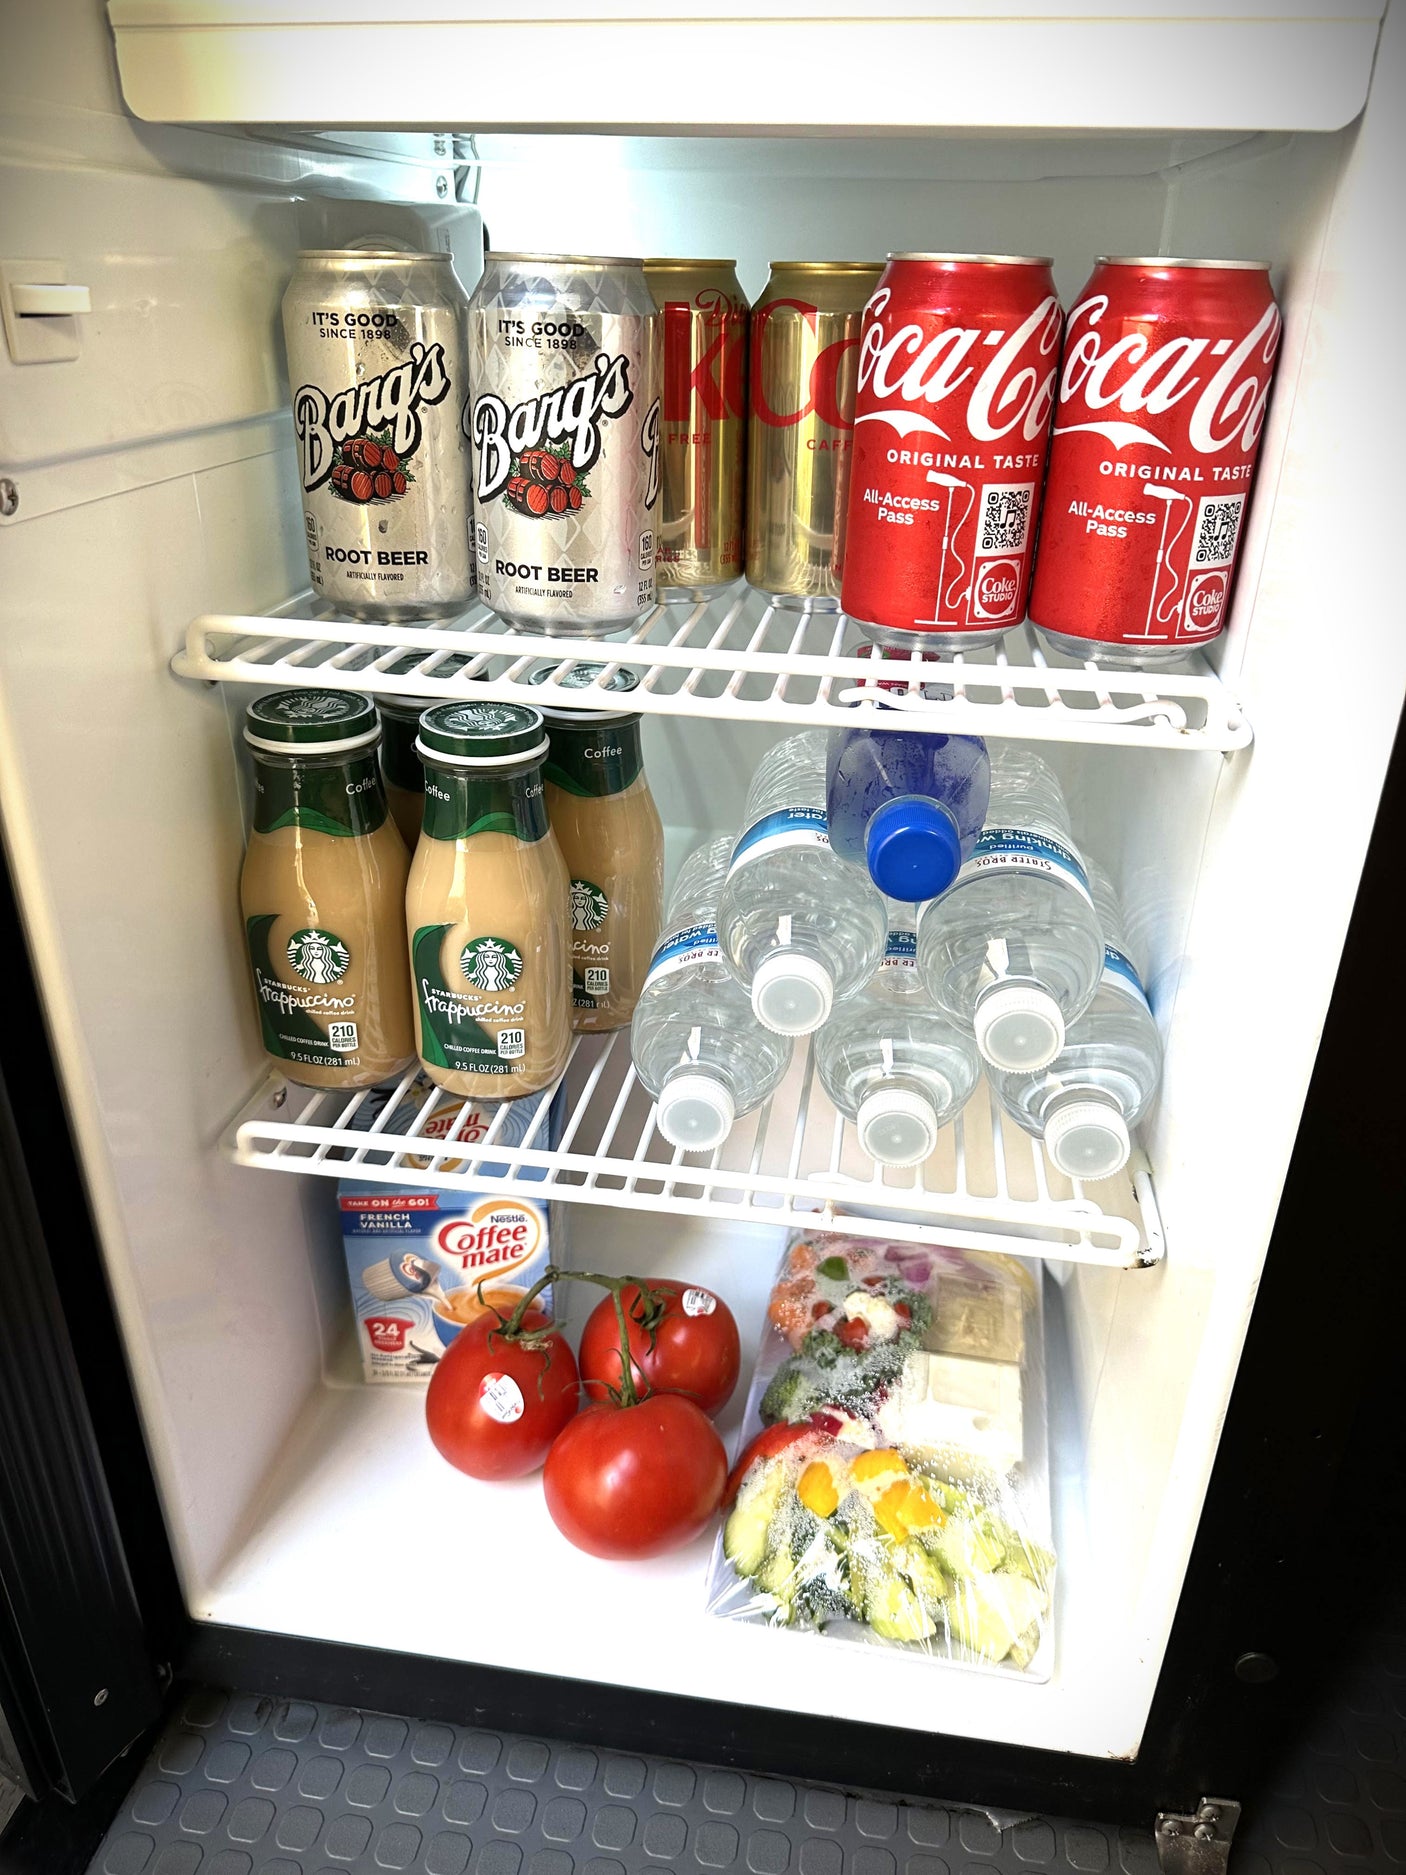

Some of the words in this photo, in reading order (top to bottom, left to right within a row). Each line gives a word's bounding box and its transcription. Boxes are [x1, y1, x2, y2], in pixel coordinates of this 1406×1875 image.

[312, 312, 339, 327] IT'S
[344, 313, 398, 328] GOOD
[320, 328, 356, 340] SINCE
[360, 329, 391, 341] 1898
[498, 319, 527, 336] IT'S
[532, 321, 585, 338] GOOD
[504, 336, 542, 349] SINCE
[546, 338, 578, 350] 1898
[293, 342, 451, 493] Barq's
[473, 352, 633, 504] Barq's
[669, 433, 711, 445] FREE
[807, 440, 853, 451] CAFF
[887, 449, 984, 469] ORIGINAL
[993, 454, 1039, 470] TASTE
[1100, 461, 1204, 482] ORIGINAL
[1212, 464, 1253, 481] TASTE
[864, 488, 940, 512] All-Access
[878, 508, 914, 526] Pass
[1068, 500, 1156, 525] All-Access
[1086, 520, 1128, 538] Pass
[325, 546, 373, 566] ROOT
[377, 550, 429, 566] BEER
[346, 571, 377, 581] ARTIFICIALLY
[378, 572, 404, 581] FLAVORED
[495, 559, 543, 581] ROOT
[547, 565, 599, 583] BEER
[515, 586, 545, 598] ARTIFICIALLY
[546, 587, 573, 599] FLAVORED
[982, 577, 1016, 595] Coke
[982, 592, 1013, 603] STUDIO
[1193, 589, 1223, 607] Coke
[1192, 604, 1219, 616] STUDIO
[584, 746, 622, 759] Coffee
[346, 777, 376, 795] Coffee
[1002, 832, 1072, 862] drinking
[660, 930, 702, 954] water
[588, 970, 607, 981] 210
[256, 968, 354, 1015] frappuccino
[264, 978, 308, 993] STARBUCKS
[422, 978, 525, 1024] frappuccino
[431, 988, 479, 1001] STARBUCKS
[578, 999, 594, 1008] (281
[332, 1025, 354, 1037] 210
[501, 1031, 522, 1044] 210
[444, 1043, 462, 1052] CHILLED
[291, 1051, 302, 1061] 9.5
[304, 1055, 312, 1063] FL
[313, 1056, 322, 1064] OZ
[324, 1057, 342, 1066] (281
[455, 1061, 468, 1071] 9.5
[469, 1063, 478, 1073] FL
[479, 1064, 489, 1073] OZ
[490, 1064, 509, 1075] (281
[511, 1063, 526, 1074] mL)
[372, 1199, 389, 1207] ON
[409, 1198, 429, 1206] GO!
[438, 1221, 527, 1255] Coffee
[462, 1242, 525, 1269] mate
[372, 1322, 400, 1336] 24
